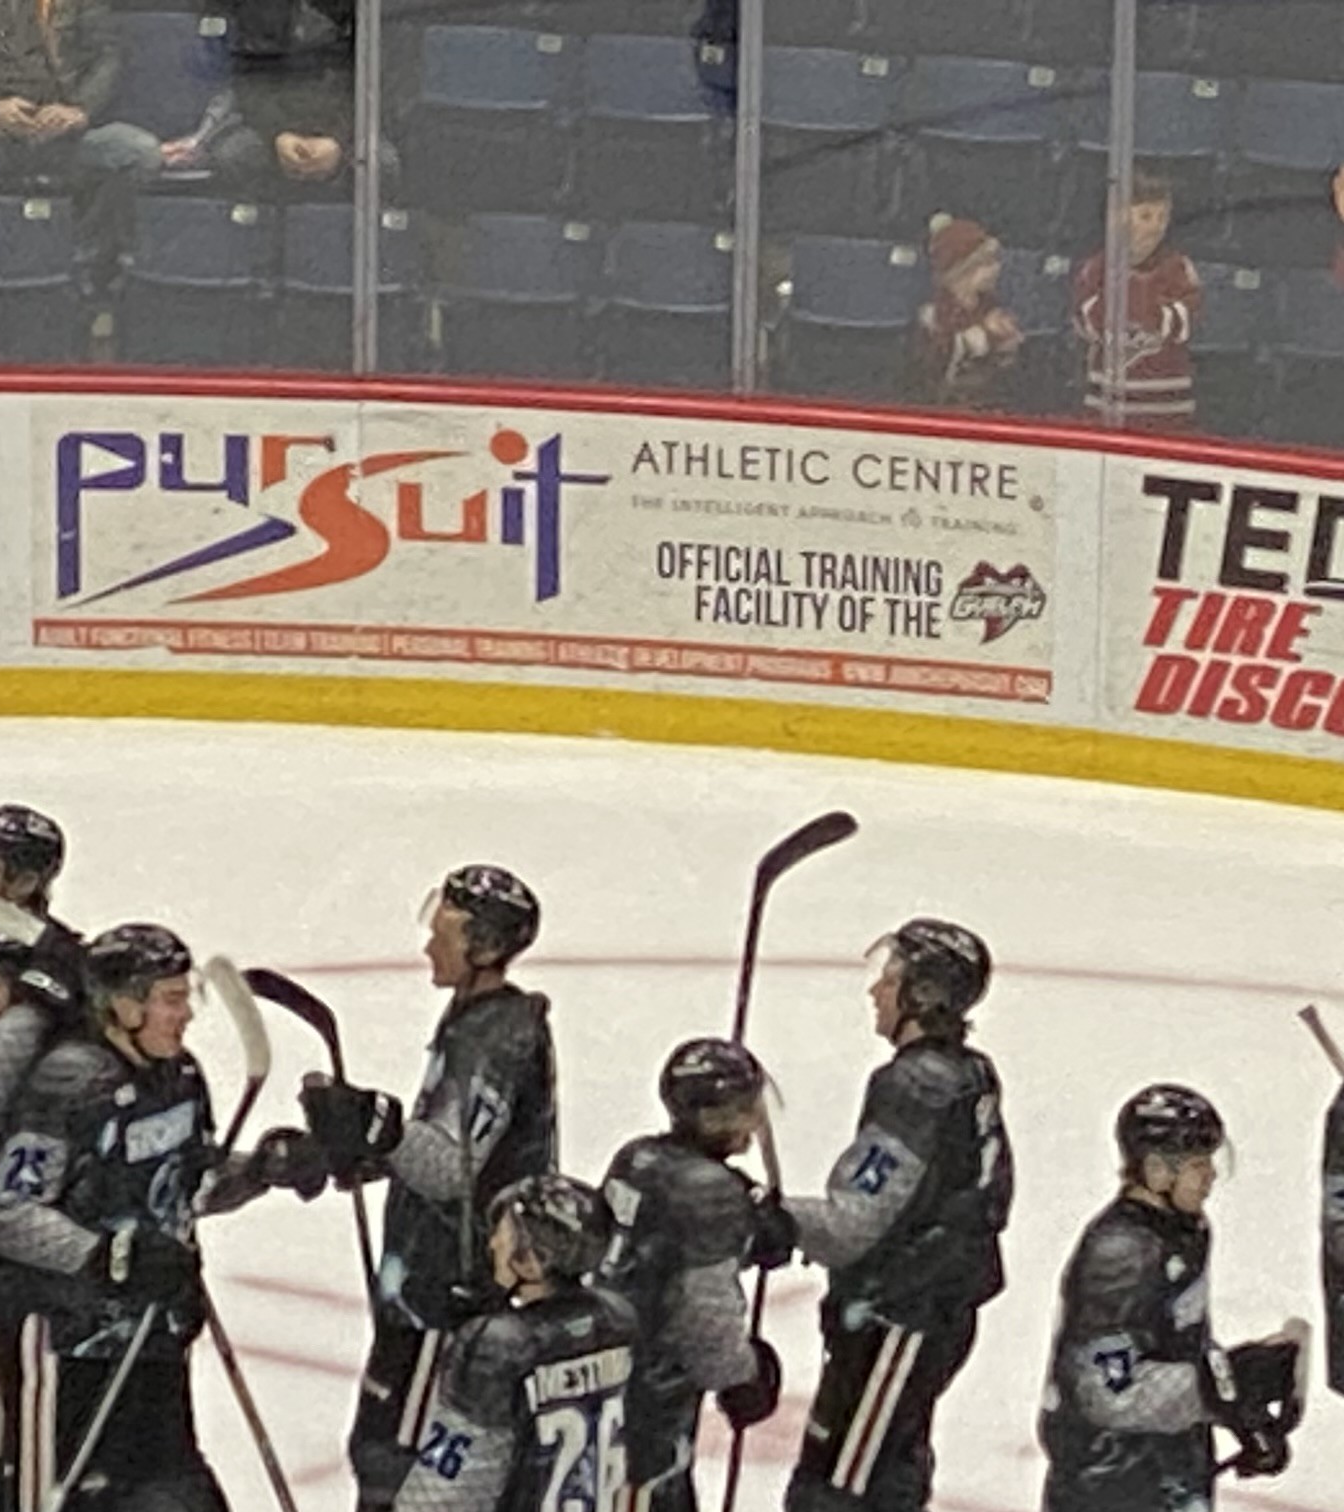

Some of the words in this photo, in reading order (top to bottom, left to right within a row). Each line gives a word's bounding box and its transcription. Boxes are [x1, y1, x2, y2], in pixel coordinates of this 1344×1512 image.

[631, 440, 831, 486] ATHLETIC
[852, 453, 1019, 500] CENTRE
[657, 540, 791, 587] OFFICIAL
[801, 550, 944, 598] TRAINING
[695, 585, 828, 630] FACILITY
[838, 595, 876, 633] OF
[884, 597, 943, 639] THE
[1143, 586, 1324, 662] TIRE
[417, 1420, 472, 1481] 26
